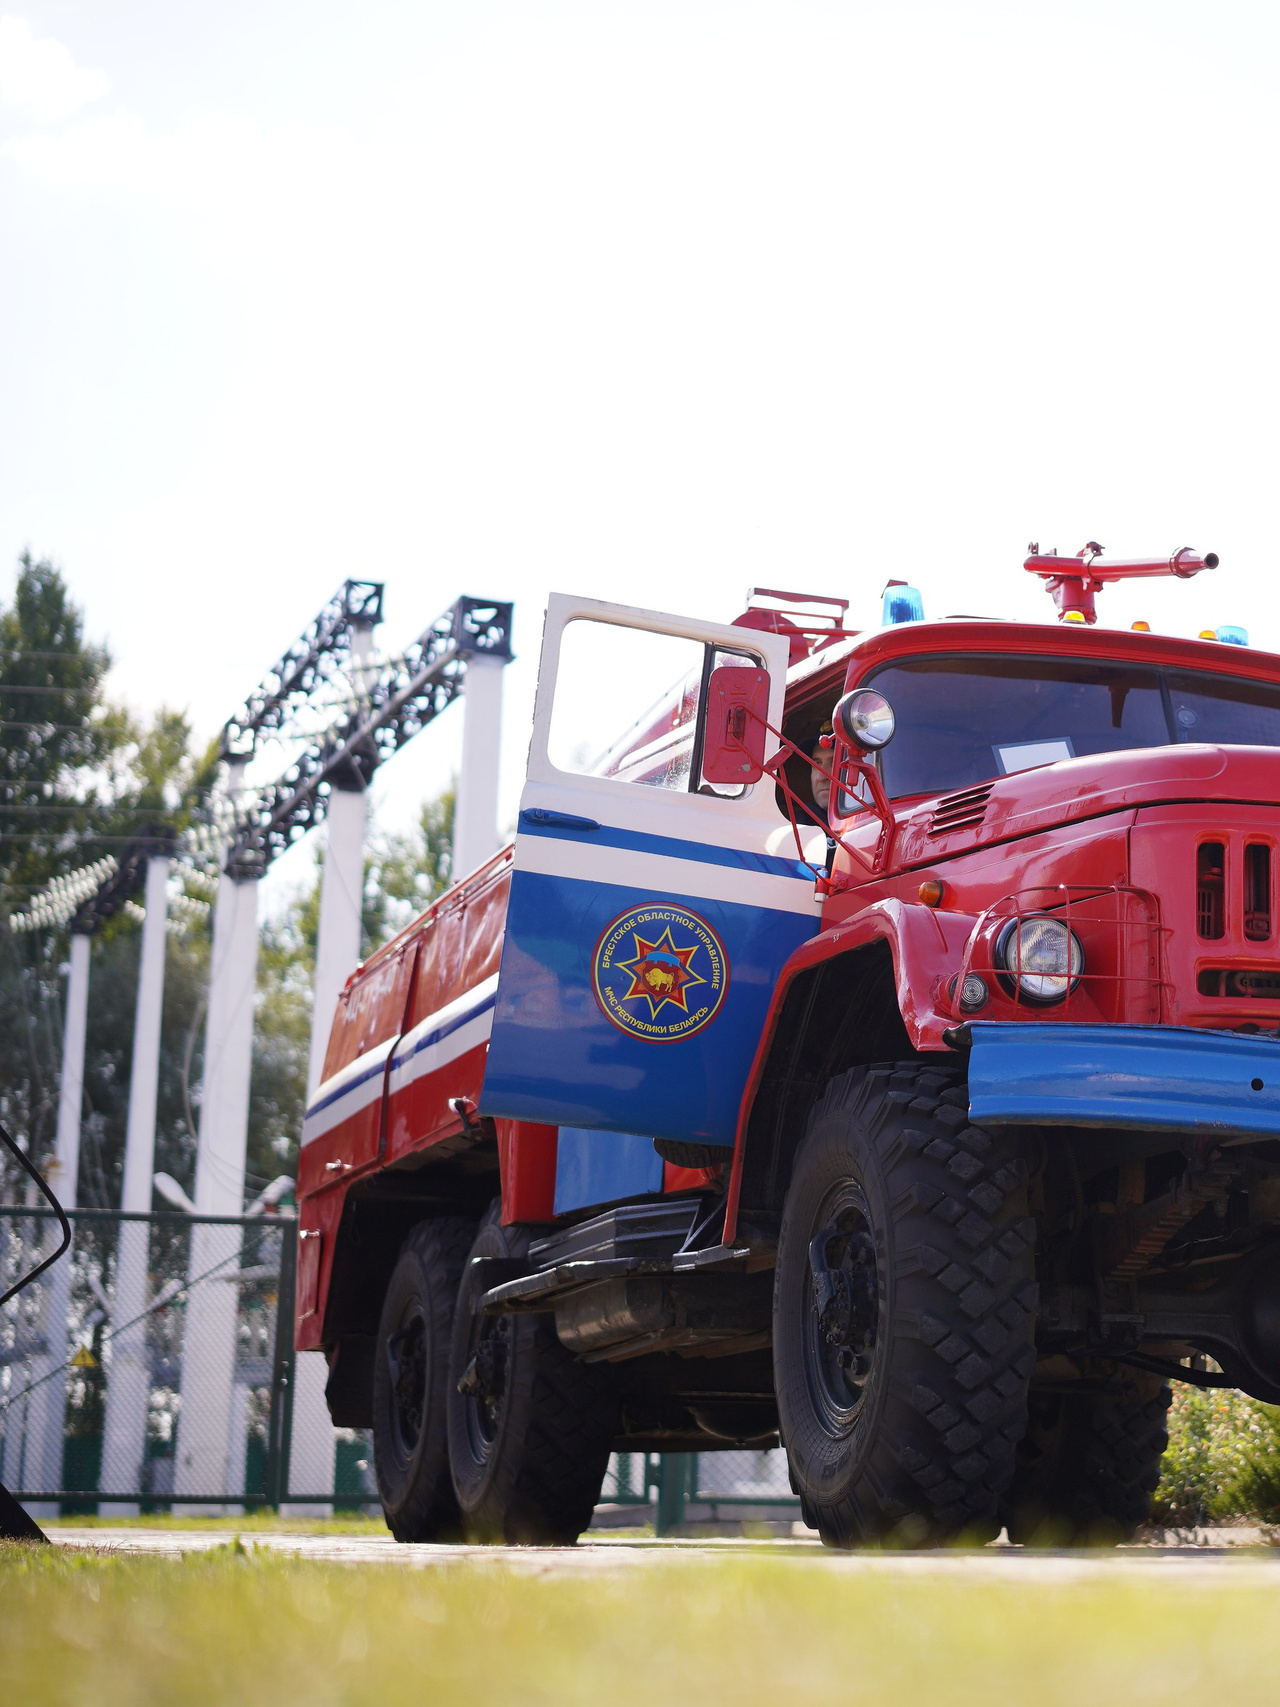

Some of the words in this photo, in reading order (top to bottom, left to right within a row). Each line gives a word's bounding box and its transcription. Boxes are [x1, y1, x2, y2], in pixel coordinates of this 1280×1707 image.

[602, 918, 637, 969] БРЕСТСКОЕ
[637, 912, 695, 930] ОБЛАСТНОЕ
[694, 927, 720, 990] УПРАВЛЕНИЕ
[604, 986, 618, 1006] МЧС
[614, 1005, 667, 1033] РЕСПУБЛИКИ
[669, 1006, 708, 1033] БЕЛАРУСЬ
